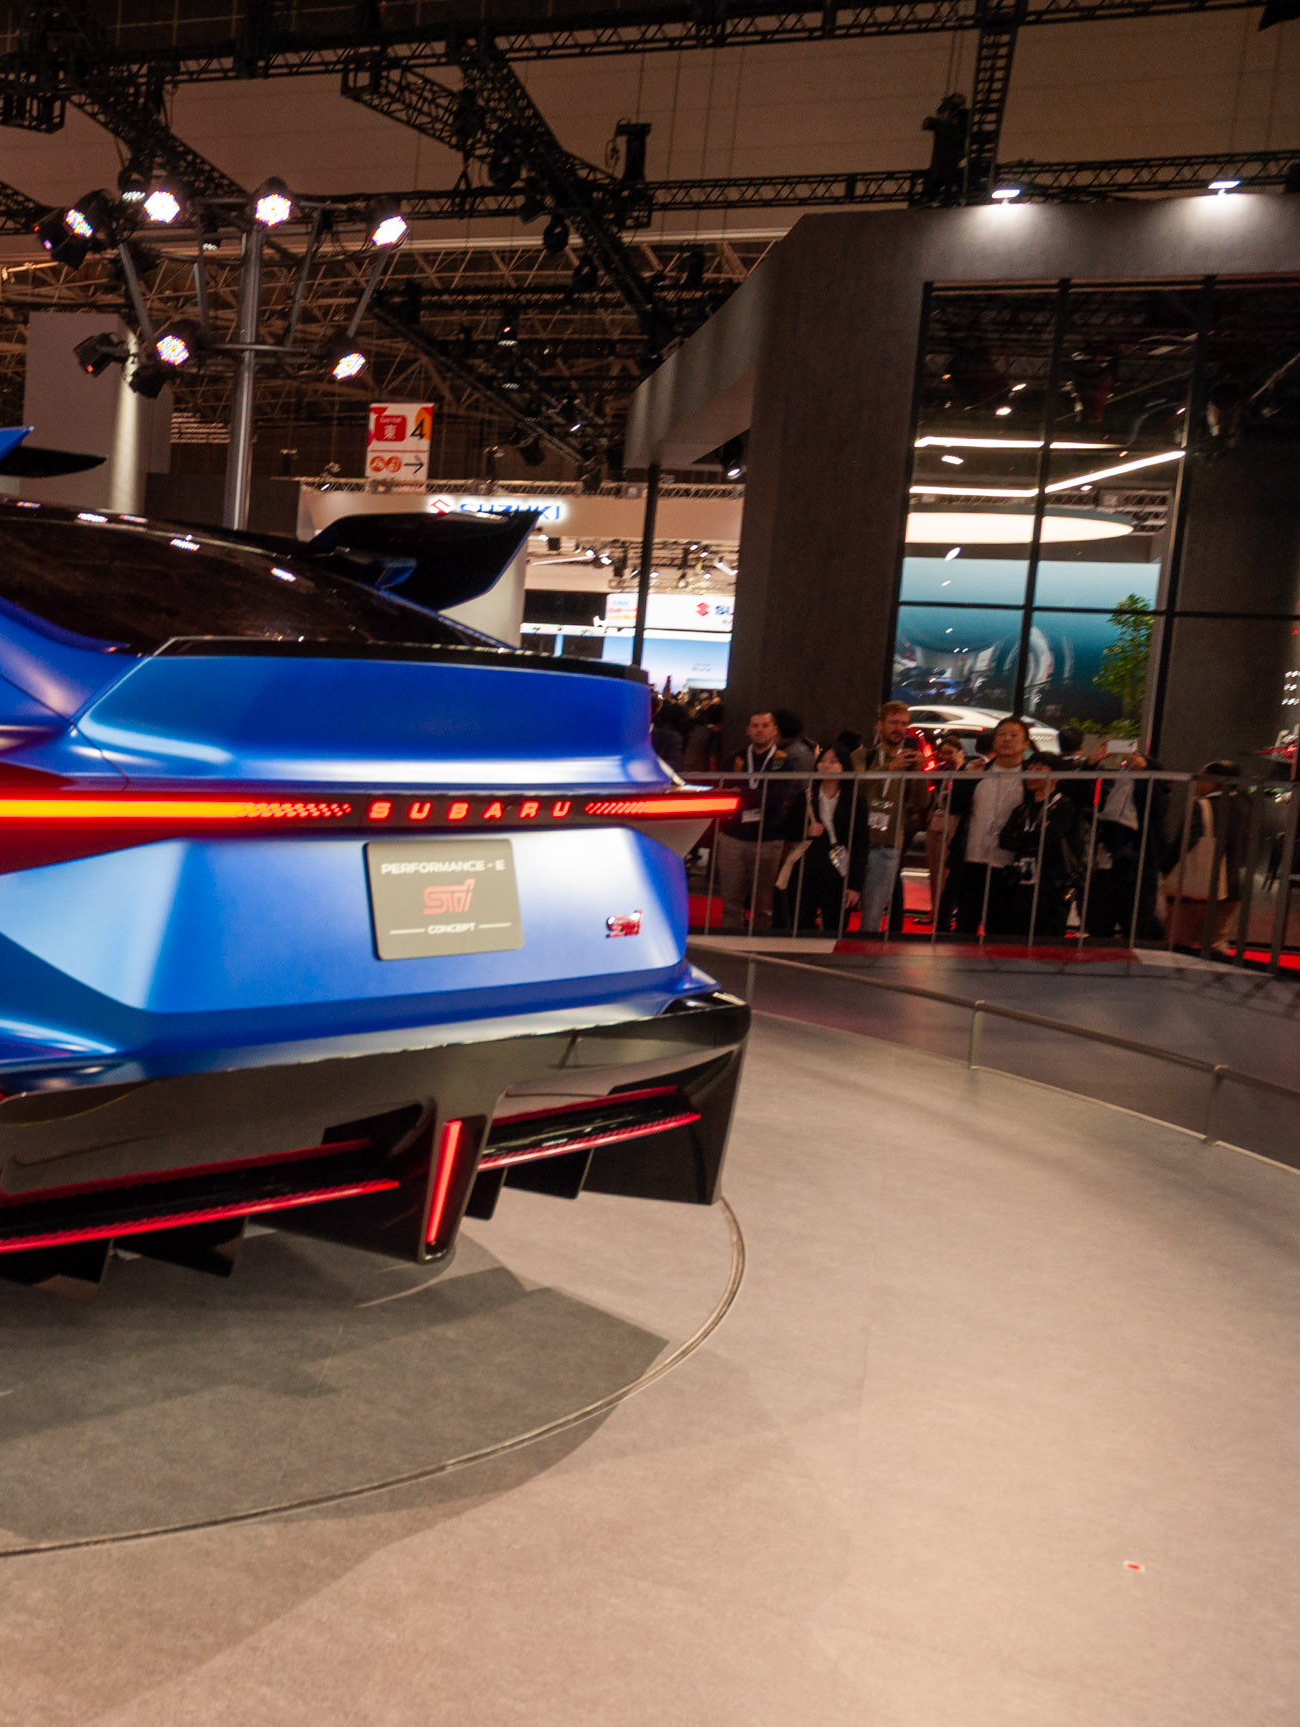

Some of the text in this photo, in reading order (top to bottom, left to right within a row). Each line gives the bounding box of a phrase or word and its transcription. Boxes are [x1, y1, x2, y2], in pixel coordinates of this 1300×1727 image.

[409, 418, 426, 440] 4
[368, 801, 571, 821] SUBARU
[380, 860, 486, 875] PERFORMANCE
[495, 859, 506, 871] E
[427, 922, 477, 935] CONCEPT
